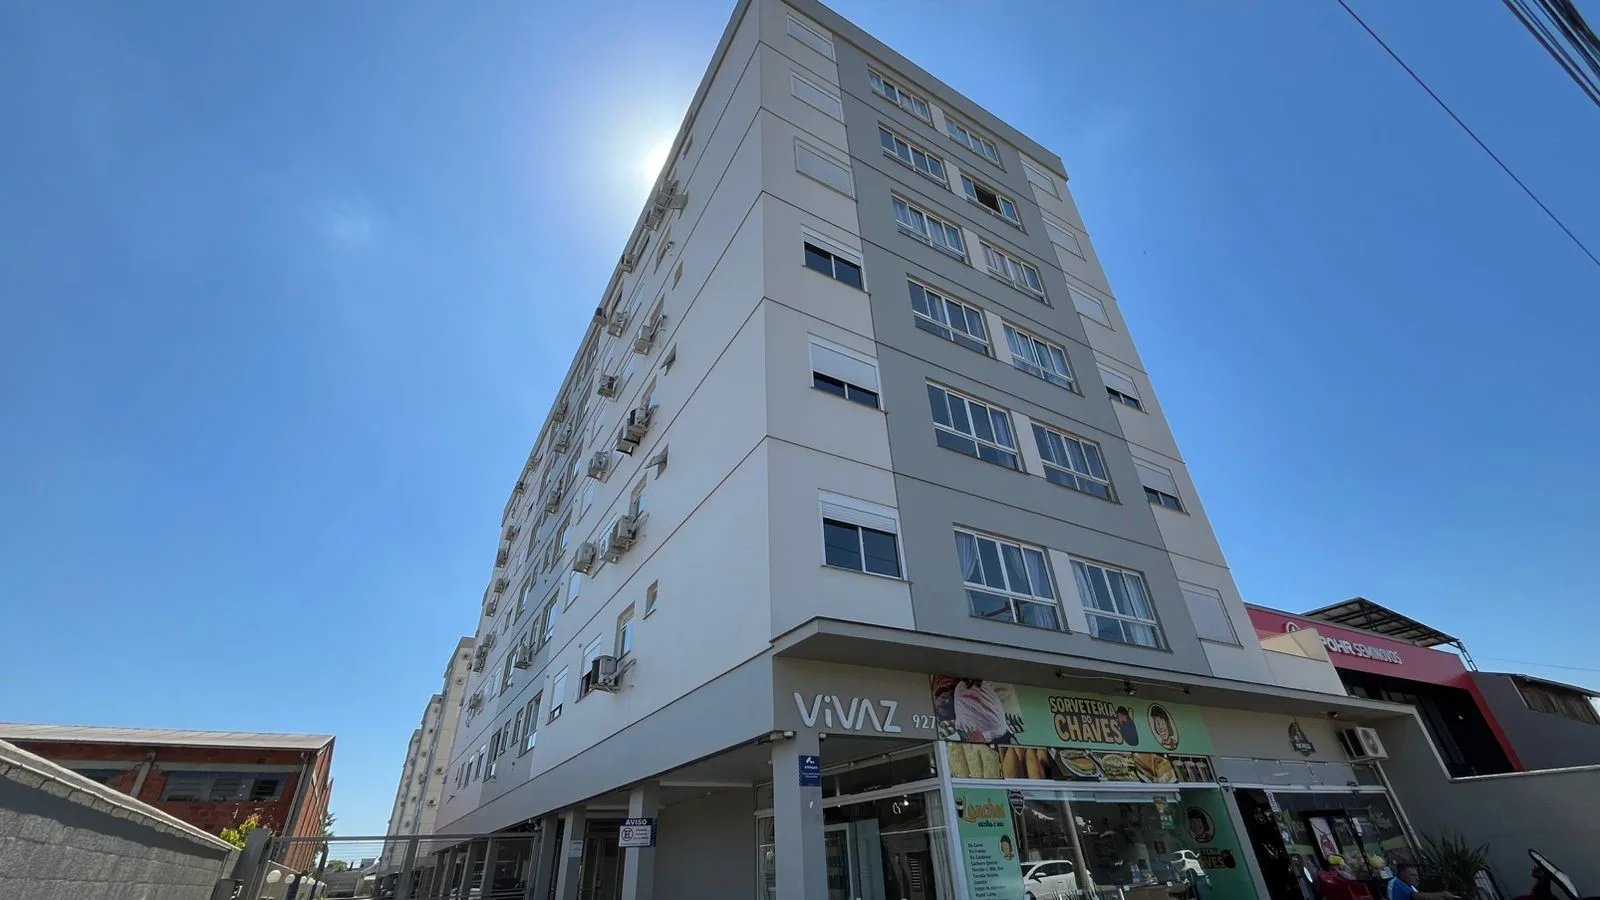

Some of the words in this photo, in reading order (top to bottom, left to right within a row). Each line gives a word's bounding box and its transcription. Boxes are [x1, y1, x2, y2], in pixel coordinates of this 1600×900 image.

[1352, 643, 1403, 664] SEMINOVOS
[1050, 697, 1117, 717] SORVETERIA
[912, 714, 936, 729] 927
[1082, 714, 1092, 724] DO
[1054, 713, 1123, 744] CHAVES
[625, 818, 648, 826] AVISO
